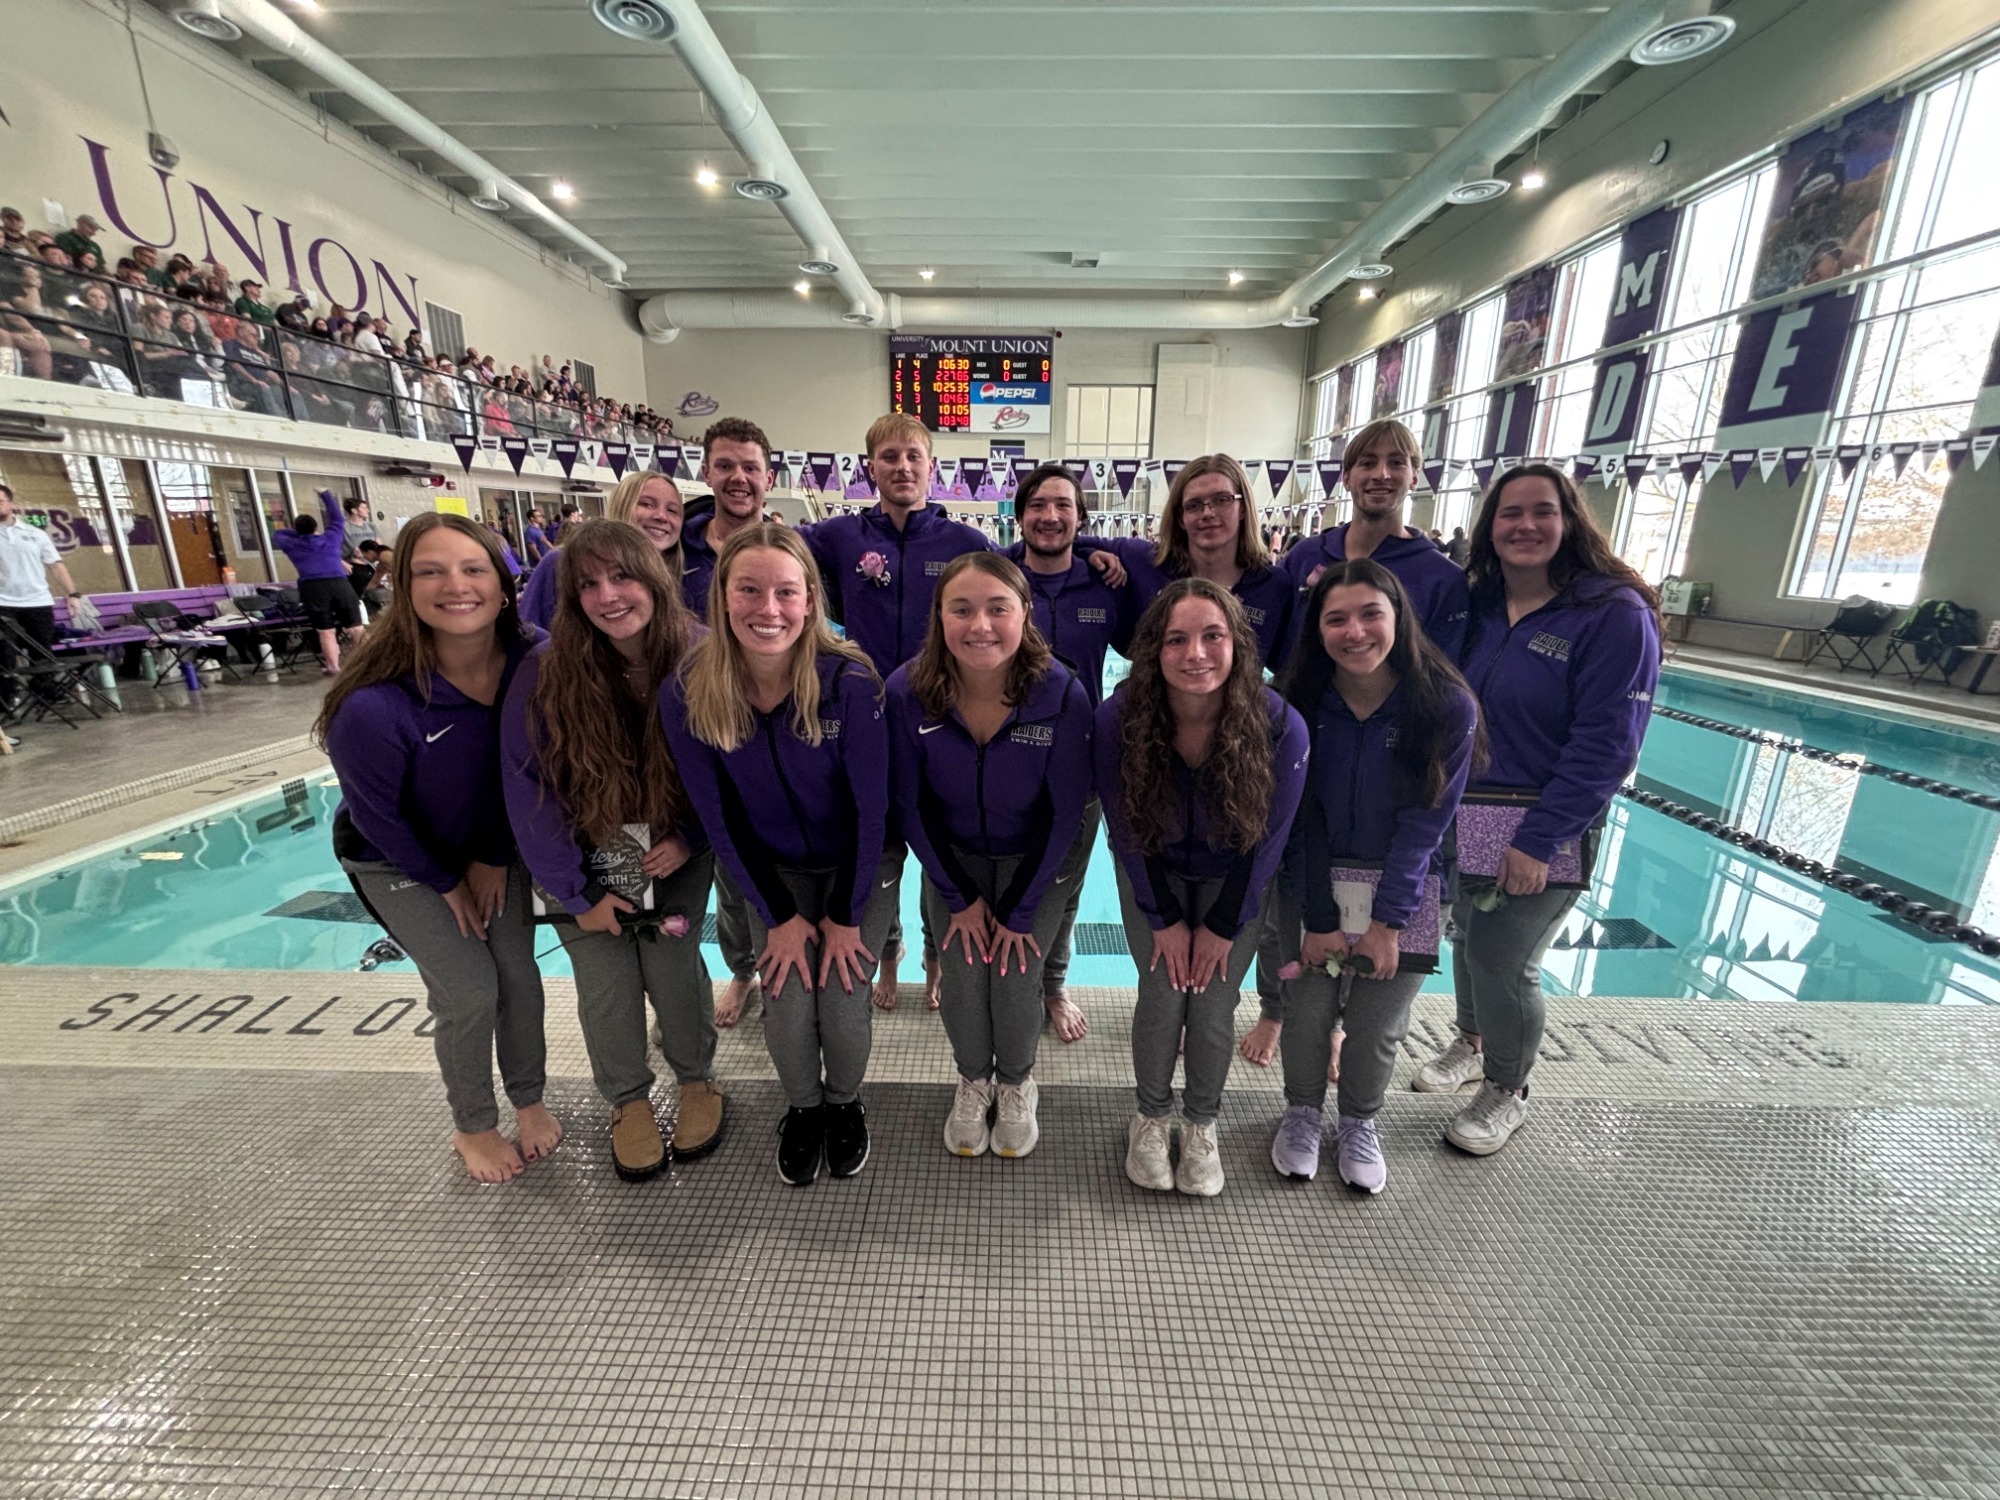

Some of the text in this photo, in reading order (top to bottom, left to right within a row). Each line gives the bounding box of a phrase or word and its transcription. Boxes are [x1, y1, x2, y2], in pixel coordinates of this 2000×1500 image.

[78, 133, 421, 330] UNION
[1614, 250, 1661, 315] M
[930, 340, 1049, 353] MOUNT UNION
[913, 359, 920, 369] 4
[1003, 359, 1010, 370] 0
[1042, 360, 1049, 371] 0
[1746, 306, 1814, 411] E
[895, 370, 902, 381] 2
[914, 370, 920, 381] 5
[1003, 371, 1010, 381] 0
[1042, 371, 1049, 382] 0
[895, 382, 902, 392] 3
[913, 381, 921, 392] 6
[995, 387, 1036, 399] PEPSI
[895, 393, 902, 402] 4
[914, 393, 921, 403] 3
[1592, 361, 1638, 441] D
[895, 404, 902, 414] 5
[586, 444, 595, 460] 1
[1871, 447, 1881, 461] 6
[841, 456, 852, 471] 2
[1095, 463, 1105, 477] 3
[1605, 458, 1617, 474] 5
[1011, 724, 1053, 741] RAIDERS
